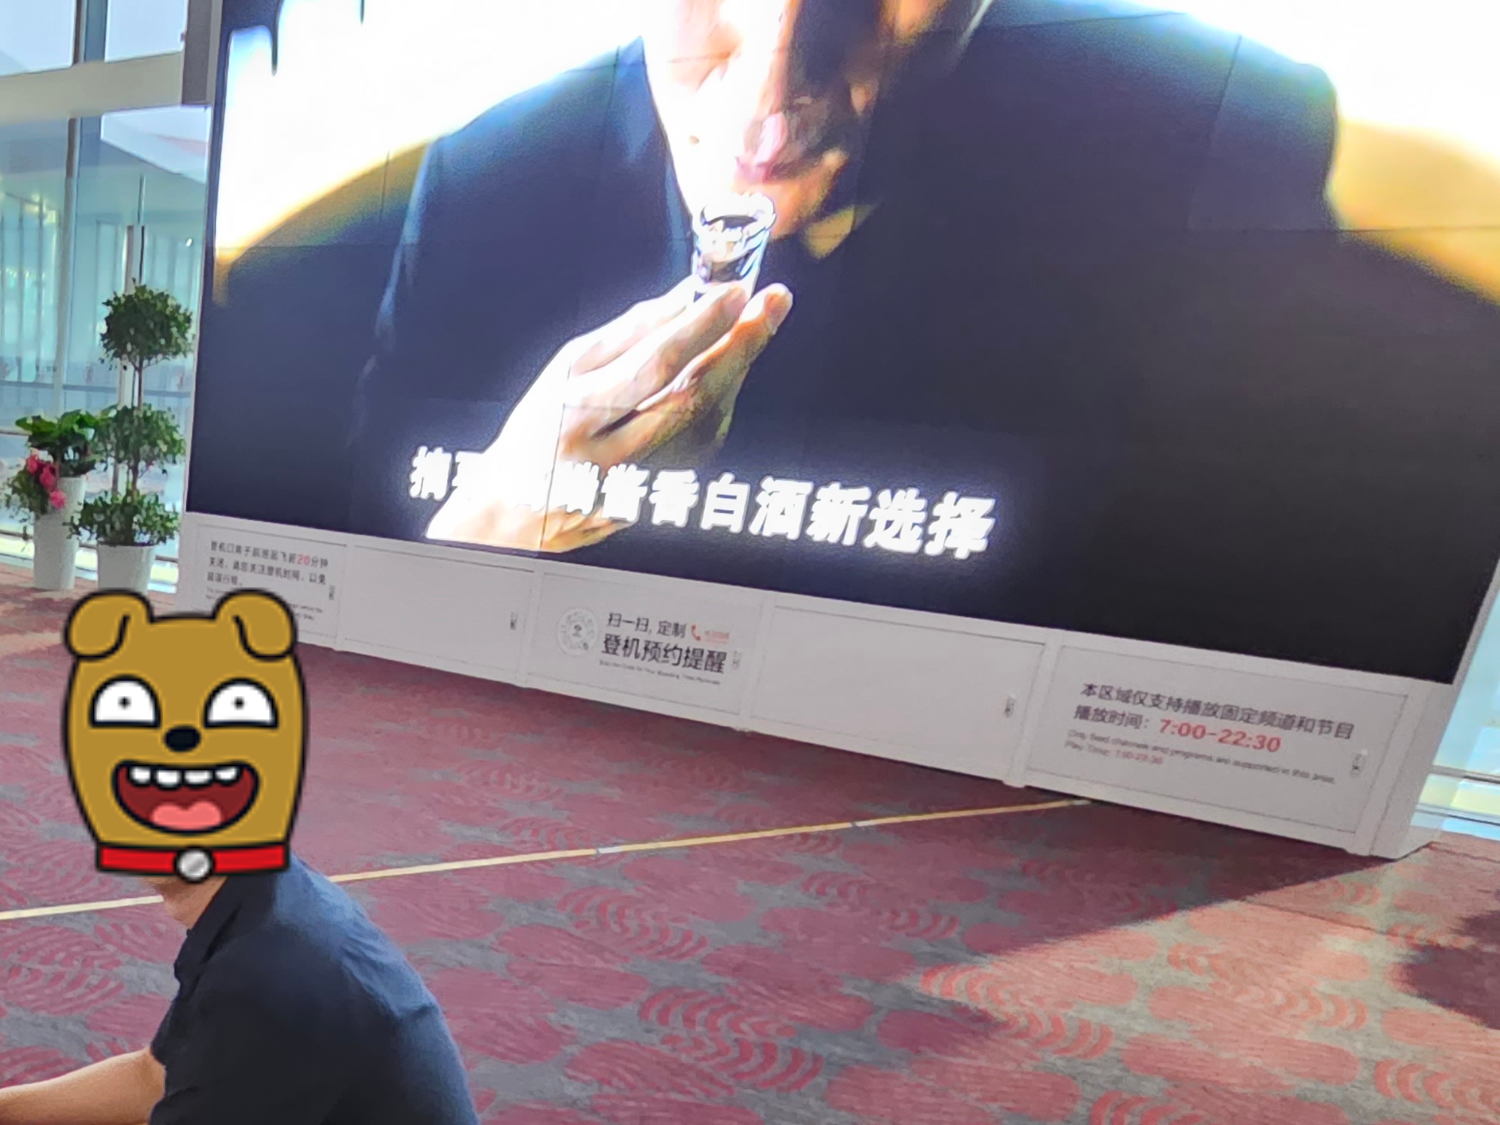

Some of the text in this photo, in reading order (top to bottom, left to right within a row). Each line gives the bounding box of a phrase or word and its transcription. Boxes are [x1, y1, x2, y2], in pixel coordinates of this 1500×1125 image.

[601, 632, 728, 675] 登机预约提醒
[1080, 682, 1355, 741] 本区域仅支持播放固定频道和节目
[1159, 717, 1283, 754] 7:00-22:30
